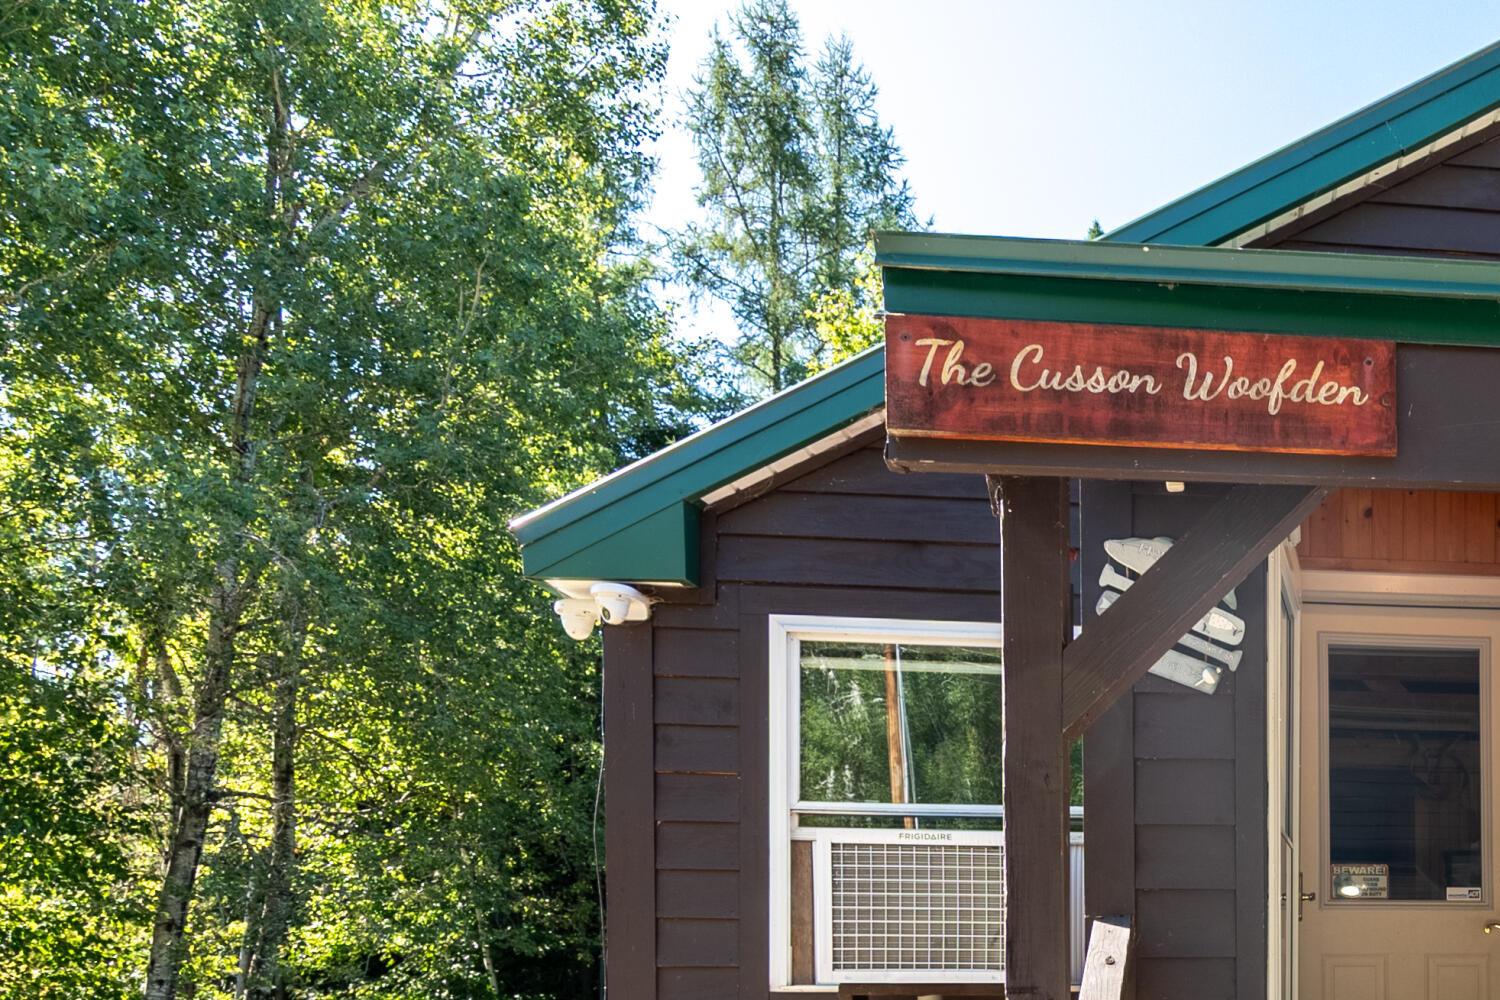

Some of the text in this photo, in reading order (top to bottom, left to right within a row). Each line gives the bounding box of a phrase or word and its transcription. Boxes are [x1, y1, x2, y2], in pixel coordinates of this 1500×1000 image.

[915, 338, 1369, 416] The Cusson Woofden
[898, 832, 953, 841] FRIGIDAIRE
[1333, 866, 1386, 875] BEWARE!
